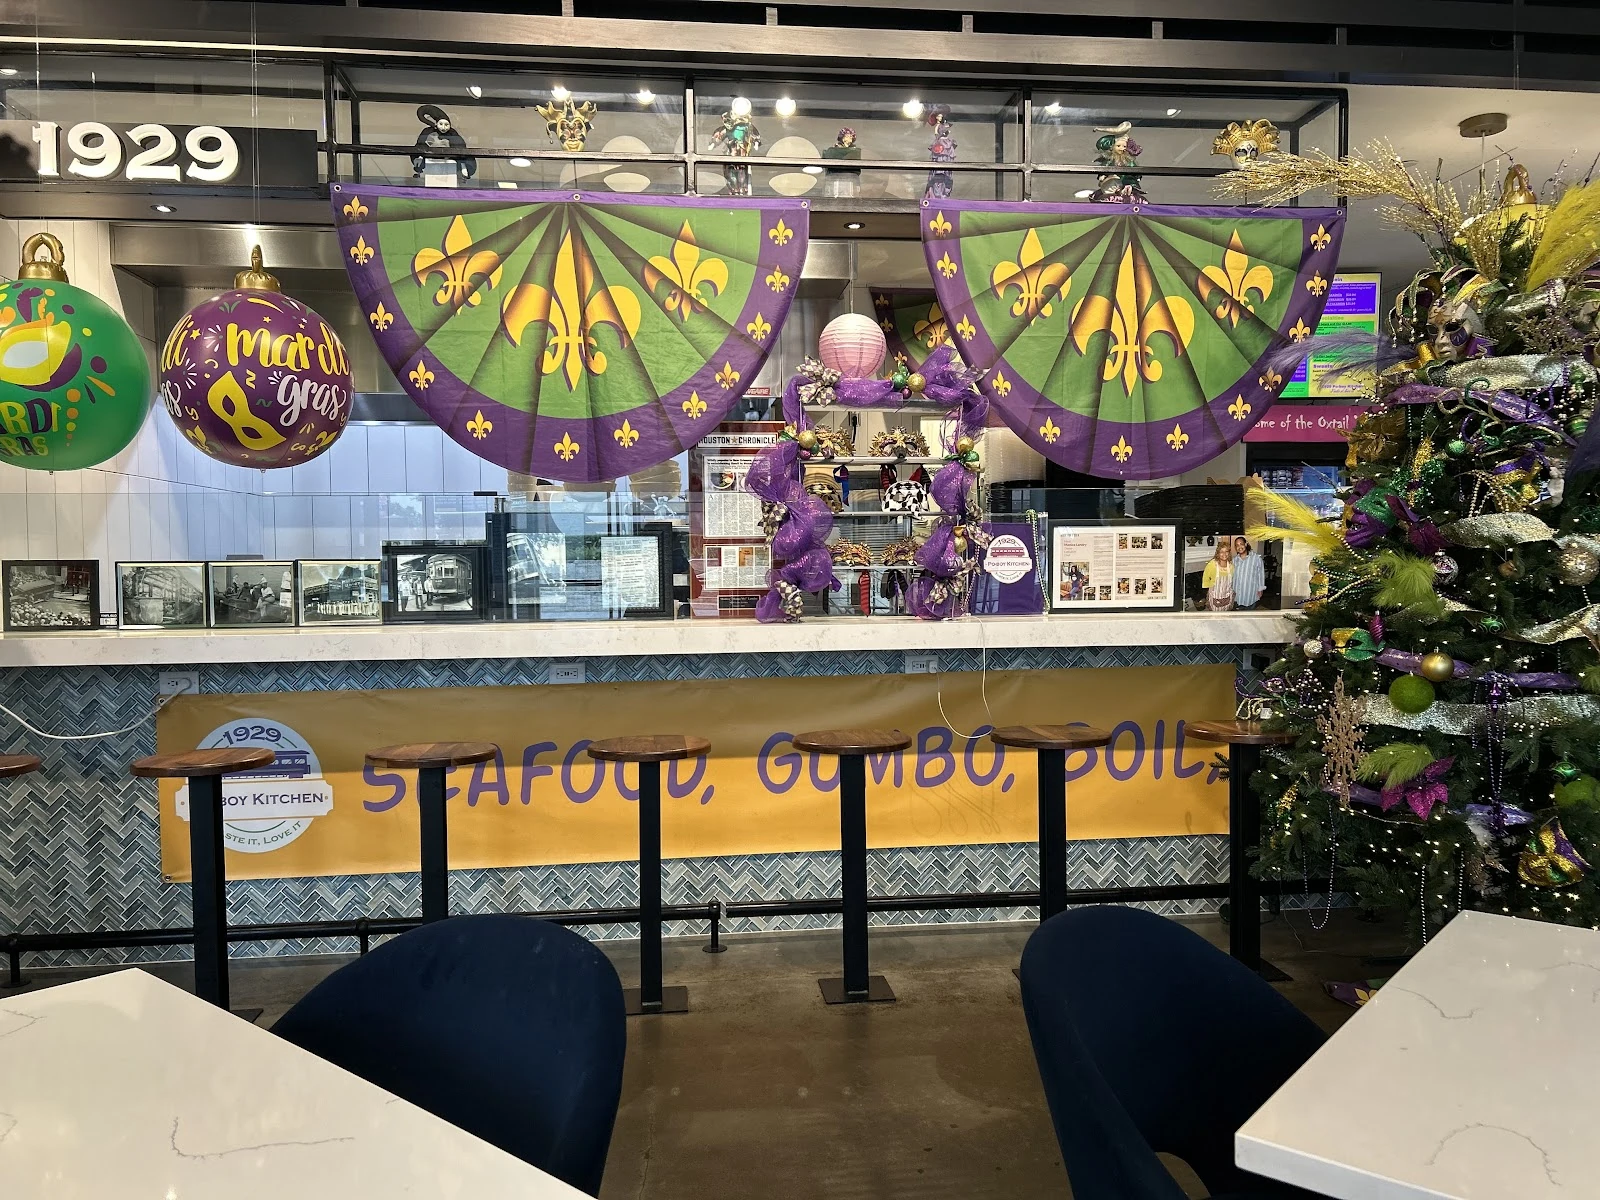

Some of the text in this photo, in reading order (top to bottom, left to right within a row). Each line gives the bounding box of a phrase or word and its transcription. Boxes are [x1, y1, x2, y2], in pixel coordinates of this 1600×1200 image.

[32, 121, 239, 182] 1929
[276, 374, 347, 427] gras
[0, 397, 62, 434] RDI
[1254, 414, 1350, 431] ome of the Oxtail
[0, 436, 49, 457] RAS
[738, 436, 776, 445] CHRONICLE
[998, 537, 1017, 546] 1929
[222, 725, 282, 745] 1929
[252, 792, 323, 806] KITCHEN
[263, 829, 293, 845] LOVE
[292, 820, 302, 831] IT
